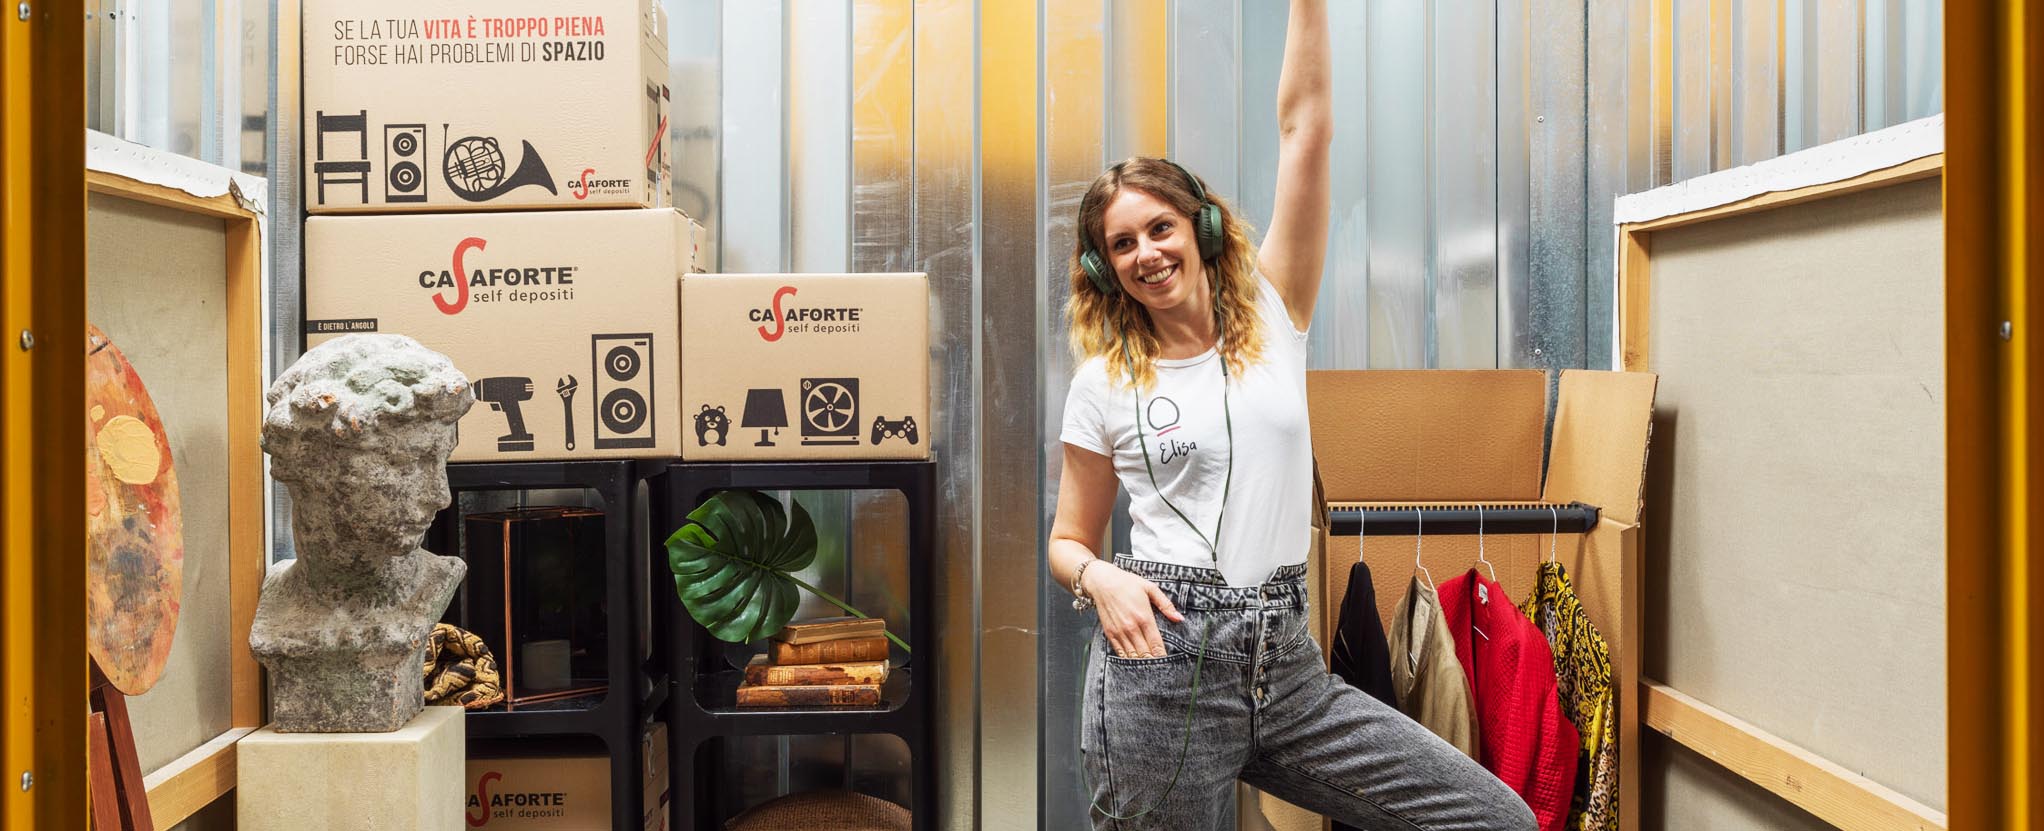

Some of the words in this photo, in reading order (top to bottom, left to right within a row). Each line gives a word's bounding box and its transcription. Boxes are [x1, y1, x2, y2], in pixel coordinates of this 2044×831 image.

[334, 20, 355, 40] SE
[359, 19, 382, 40] LA
[385, 18, 419, 40] TUA
[423, 17, 462, 40] VITA
[467, 14, 477, 39] È
[482, 17, 549, 38] TROPPO
[554, 15, 605, 37] PIENA
[334, 44, 388, 66] FORSE
[395, 43, 424, 65] HAI
[430, 41, 515, 64] PROBLEMI
[521, 41, 536, 62] DI
[542, 40, 605, 62] SPAZIO
[473, 290, 502, 303] self
[509, 288, 575, 304] depositi
[323, 322, 344, 331] DIETRO
[788, 324, 809, 333] self
[813, 323, 860, 334] depositi
[1160, 440, 1197, 465] Elisa
[465, 771, 564, 827] ASAFORTE
[494, 809, 513, 818] self
[519, 808, 564, 819] depositi
